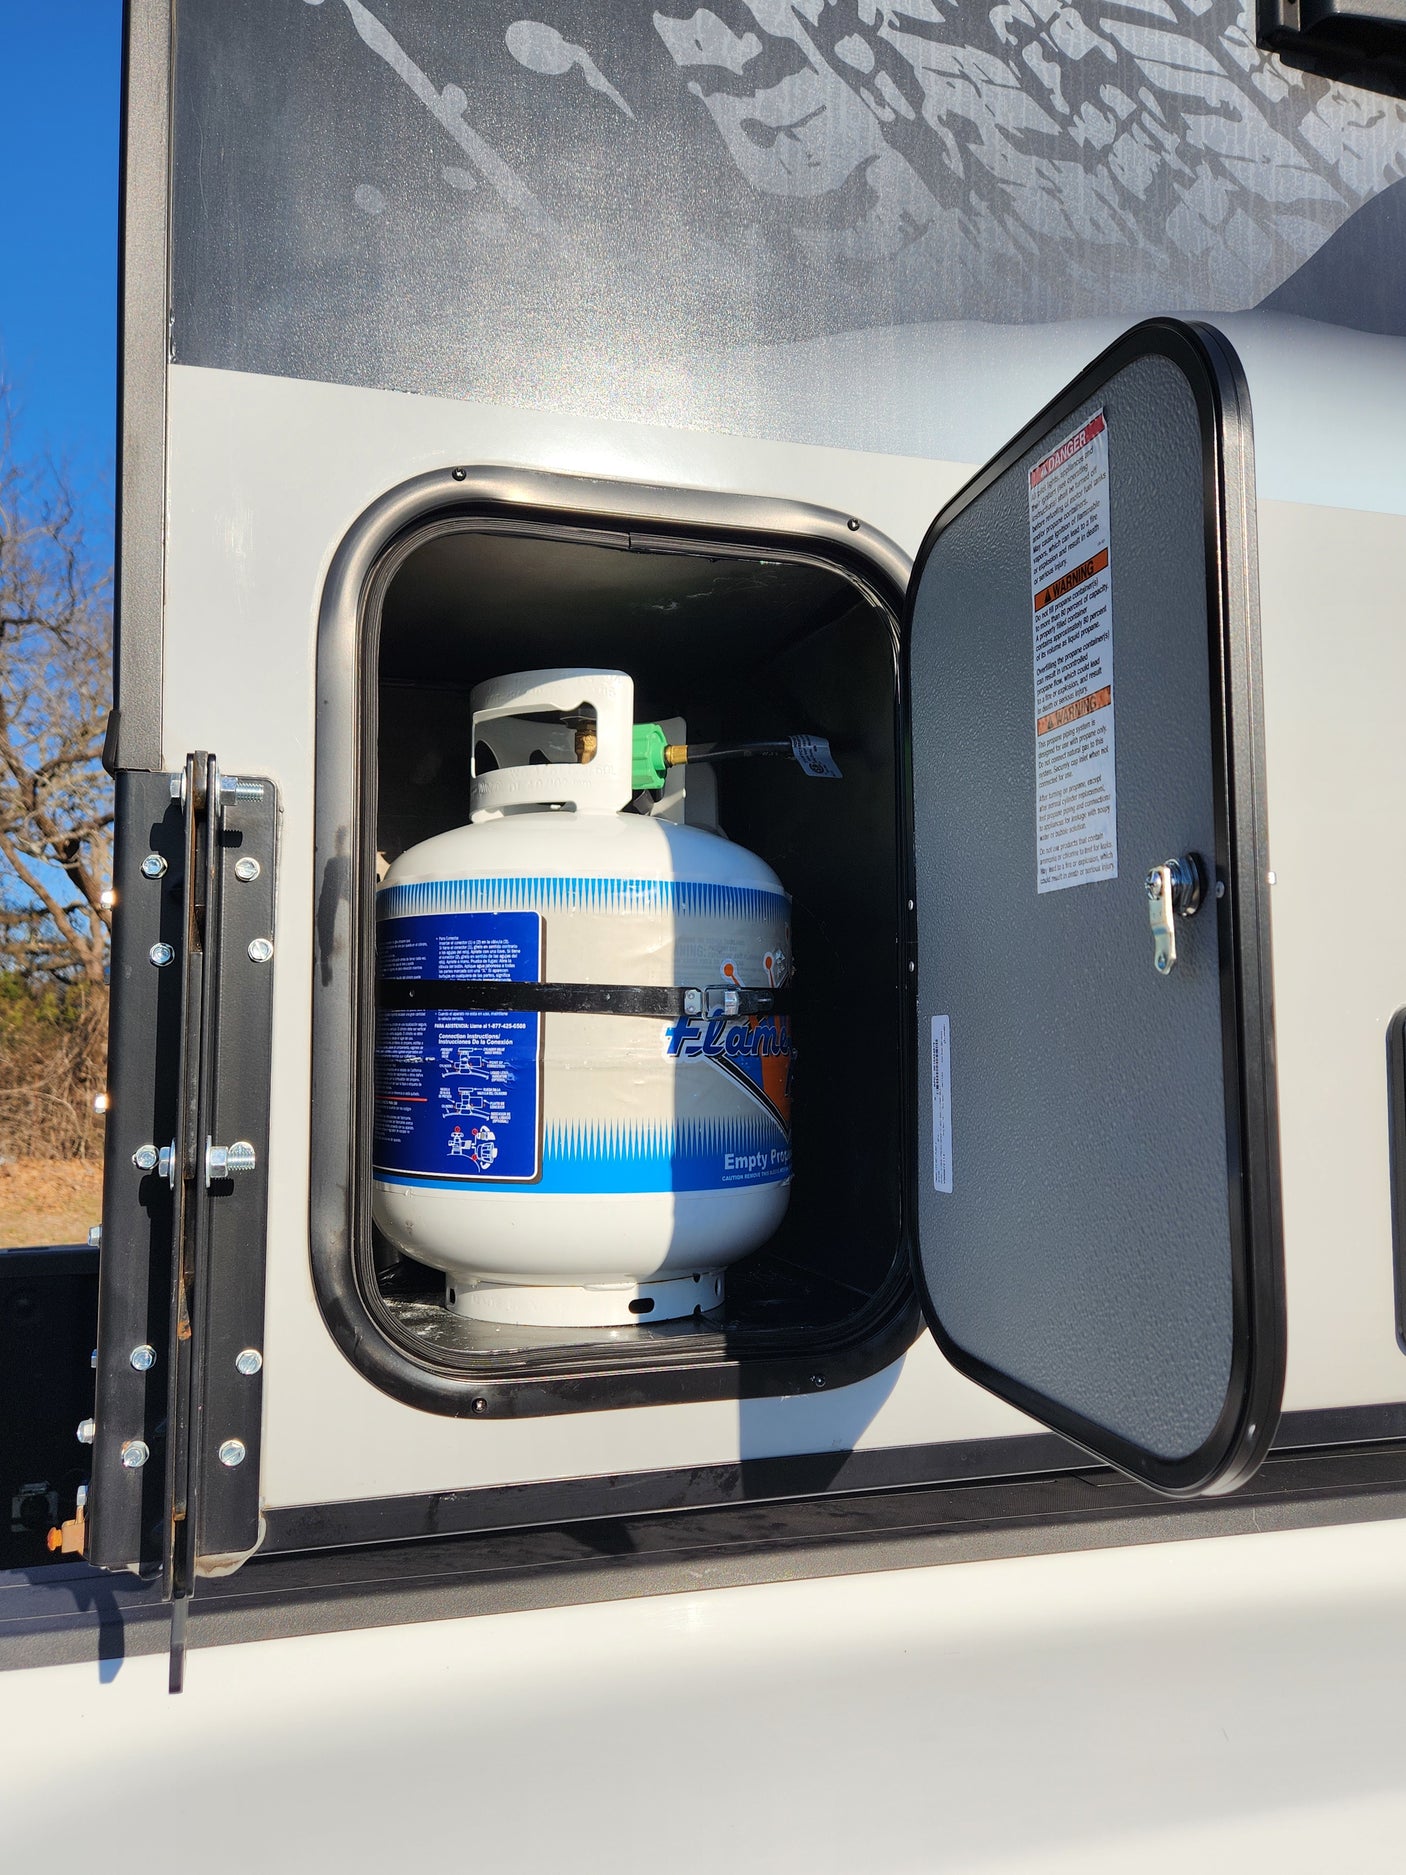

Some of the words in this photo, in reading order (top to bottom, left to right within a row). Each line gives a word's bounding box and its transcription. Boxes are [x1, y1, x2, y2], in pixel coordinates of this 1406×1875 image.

[1048, 430, 1087, 471] DANGER
[1053, 560, 1094, 598] WARNING
[1056, 696, 1097, 724] WARNING
[724, 1152, 768, 1171] Empty
